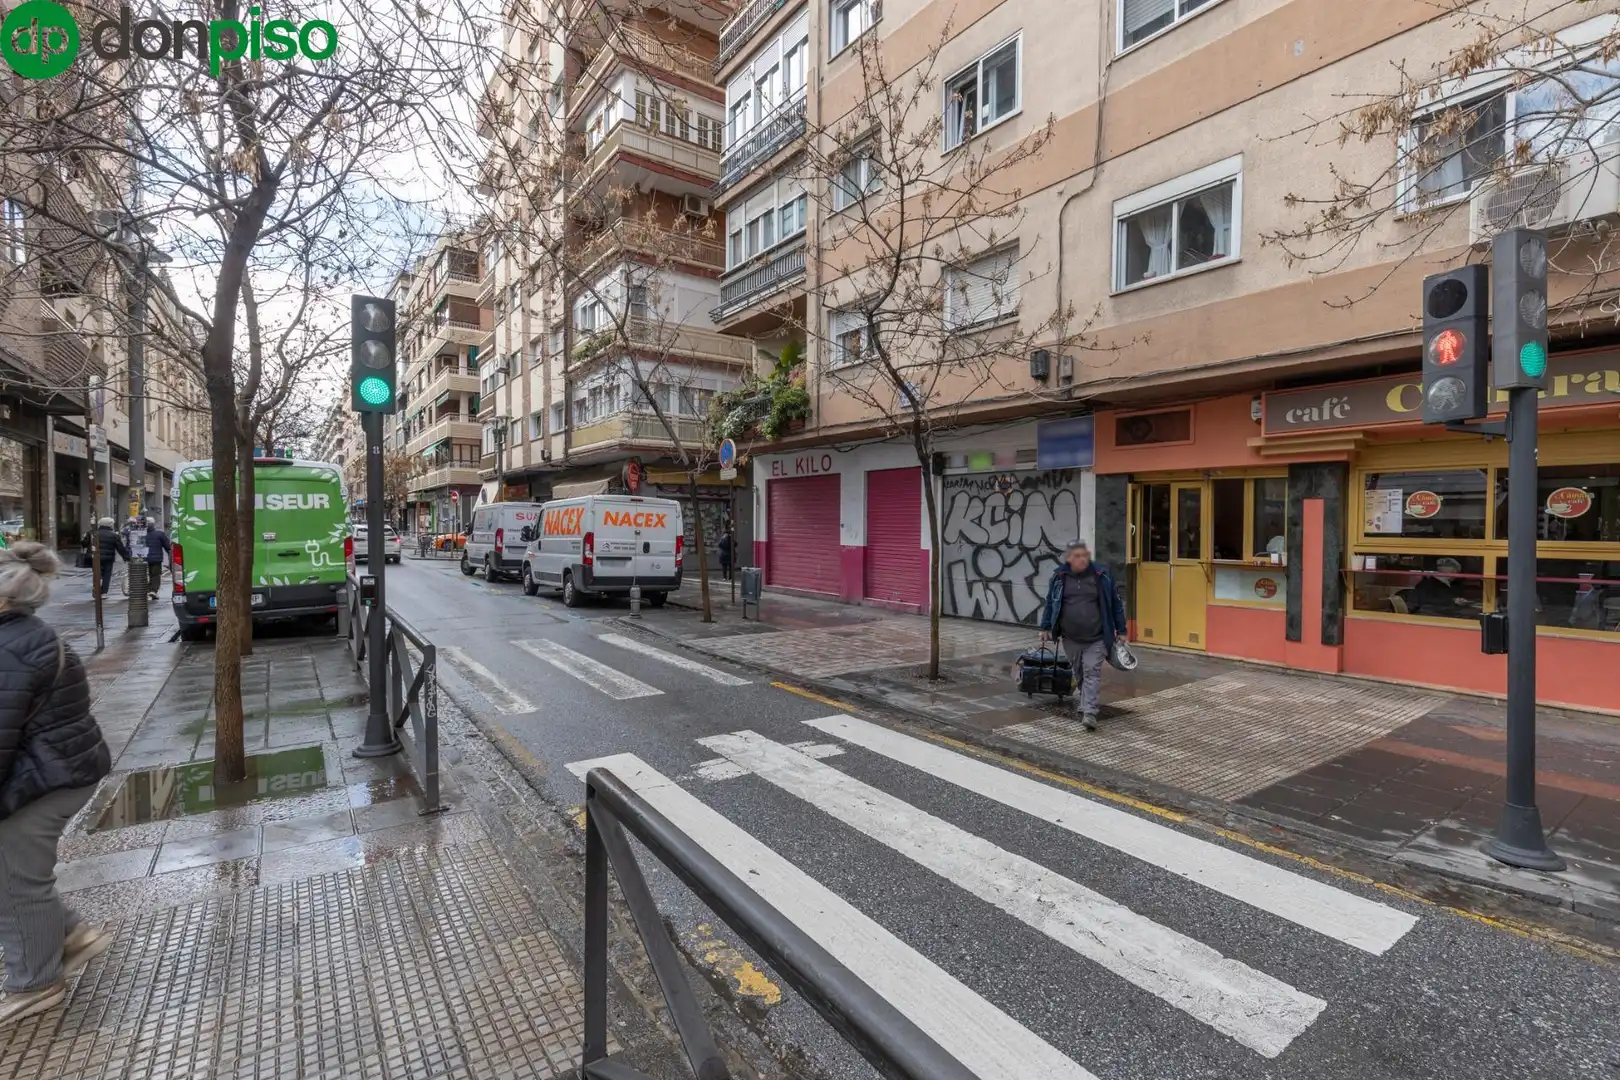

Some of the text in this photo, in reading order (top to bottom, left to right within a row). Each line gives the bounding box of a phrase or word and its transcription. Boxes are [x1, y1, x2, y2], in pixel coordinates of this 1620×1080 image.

[1285, 396, 1352, 424] café
[772, 454, 832, 477] EL KILO
[265, 493, 330, 511] SEUR
[543, 507, 585, 536] NACEX
[603, 510, 667, 529] NACEX
